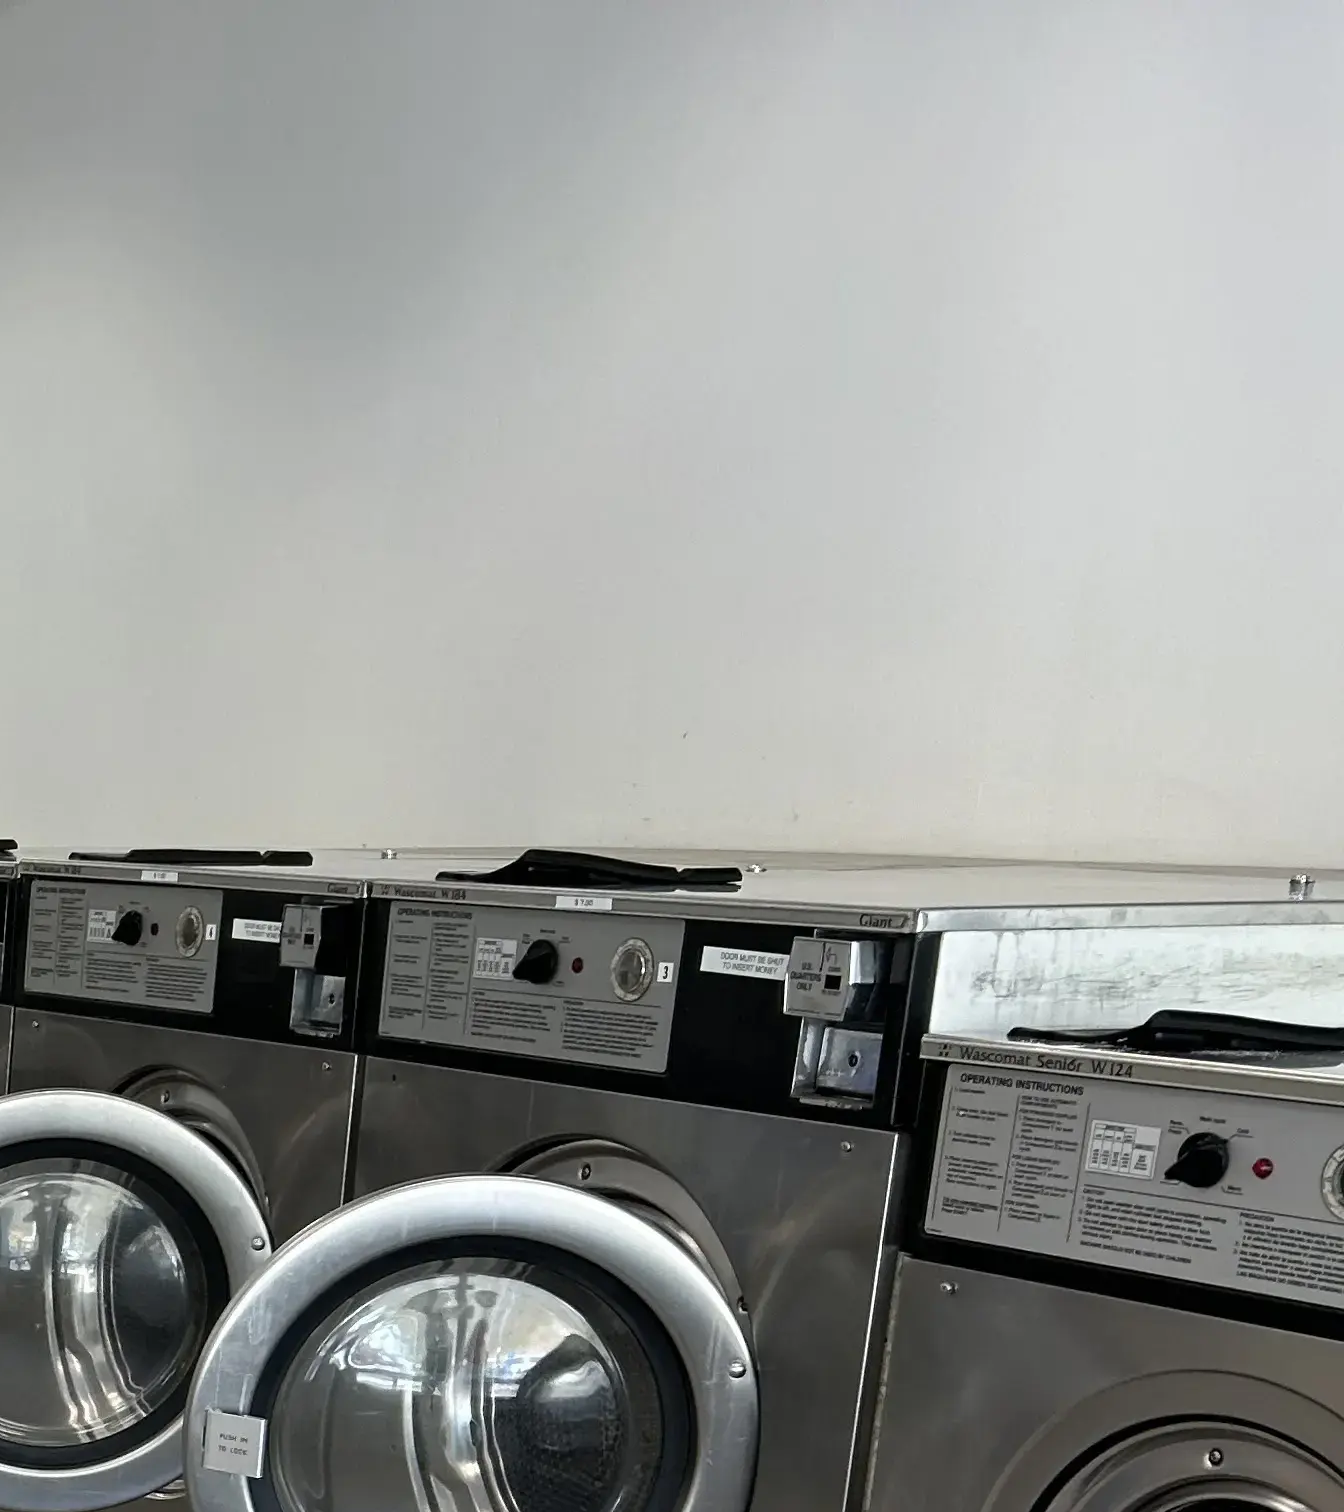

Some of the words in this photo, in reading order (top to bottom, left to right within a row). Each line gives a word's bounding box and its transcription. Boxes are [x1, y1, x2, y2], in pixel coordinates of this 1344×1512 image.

[720, 951, 738, 960] DOOR
[767, 957, 784, 965] SHUT
[662, 965, 669, 979] 3
[722, 961, 731, 969] TO
[732, 963, 754, 972] INSERT
[755, 965, 778, 974] MONEY
[959, 1046, 1031, 1068] Wascomat
[1036, 1054, 1083, 1072] Senior
[960, 1073, 1013, 1088] OPERATING
[1015, 1081, 1084, 1096] INSTRUCTIONS
[220, 1433, 237, 1441] PUSH
[218, 1445, 227, 1453] TO
